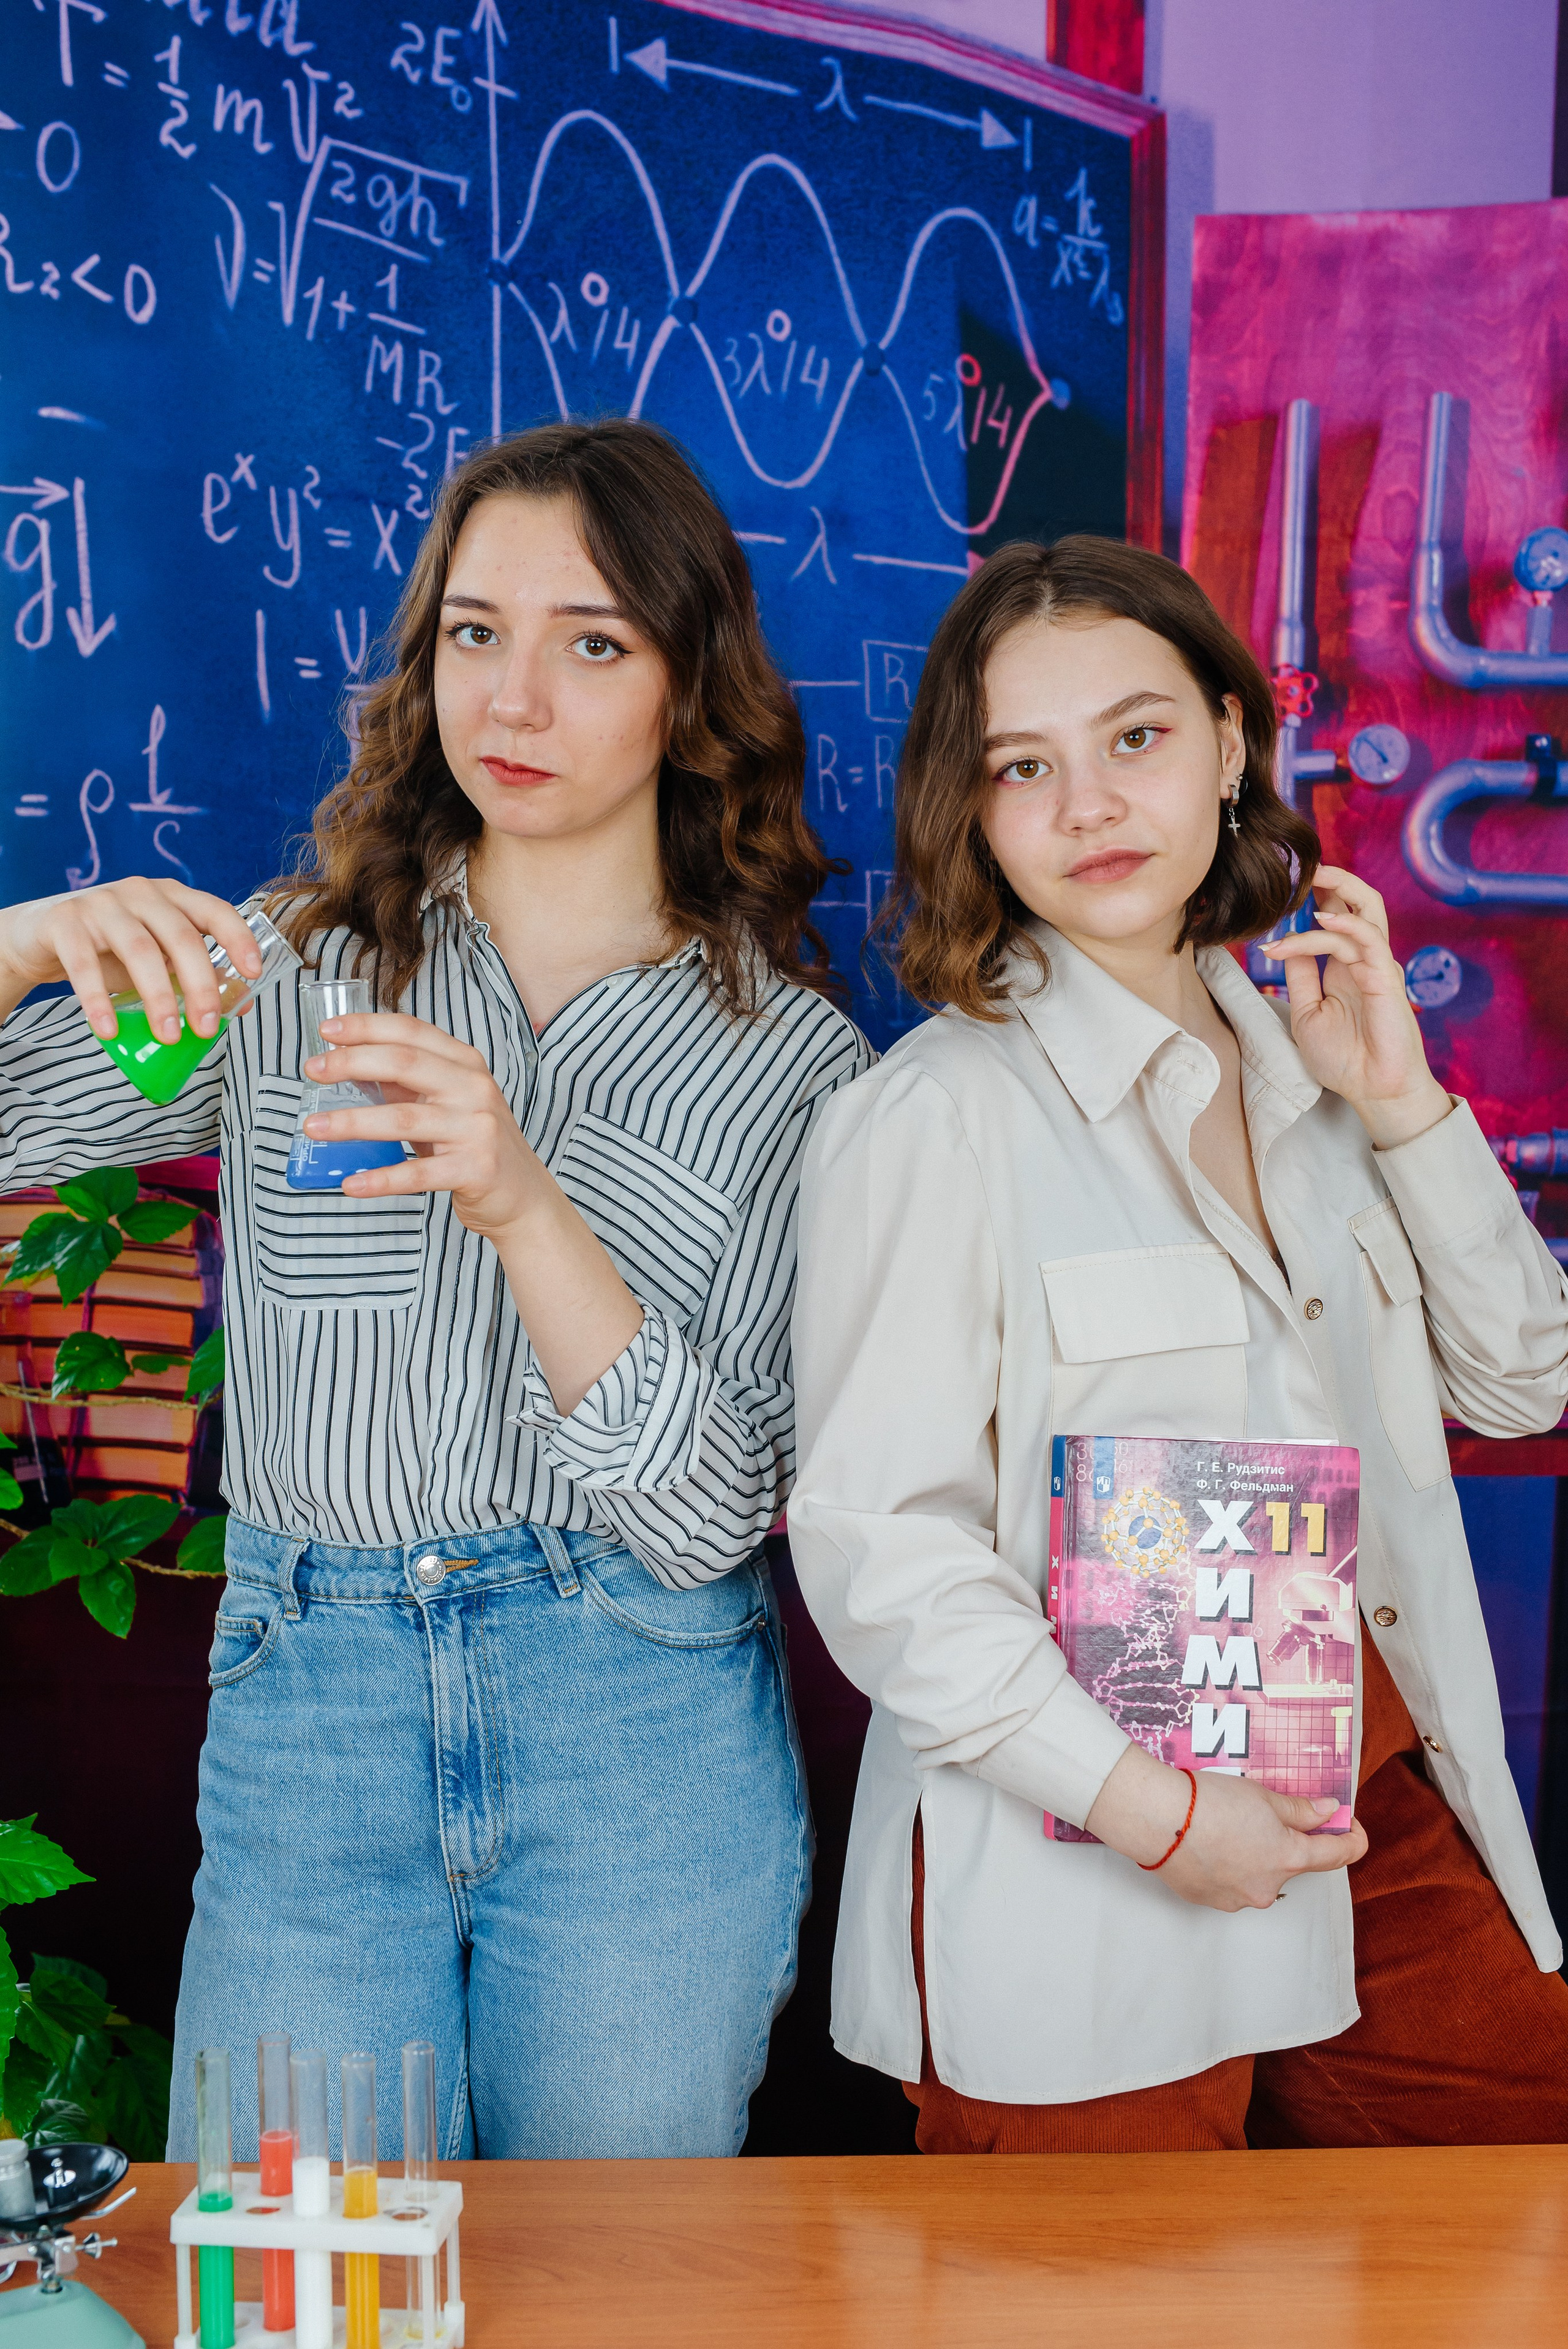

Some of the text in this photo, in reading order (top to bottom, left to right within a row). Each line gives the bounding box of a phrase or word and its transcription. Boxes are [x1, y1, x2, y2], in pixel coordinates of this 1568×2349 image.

[1197, 1461, 1285, 1476] Г. Е. Рудзитис
[1196, 1479, 1294, 1493] Ф. Г. Фельдман
[1265, 1502, 1326, 1555] 11
[1182, 1499, 1263, 1777] ХИМИ
